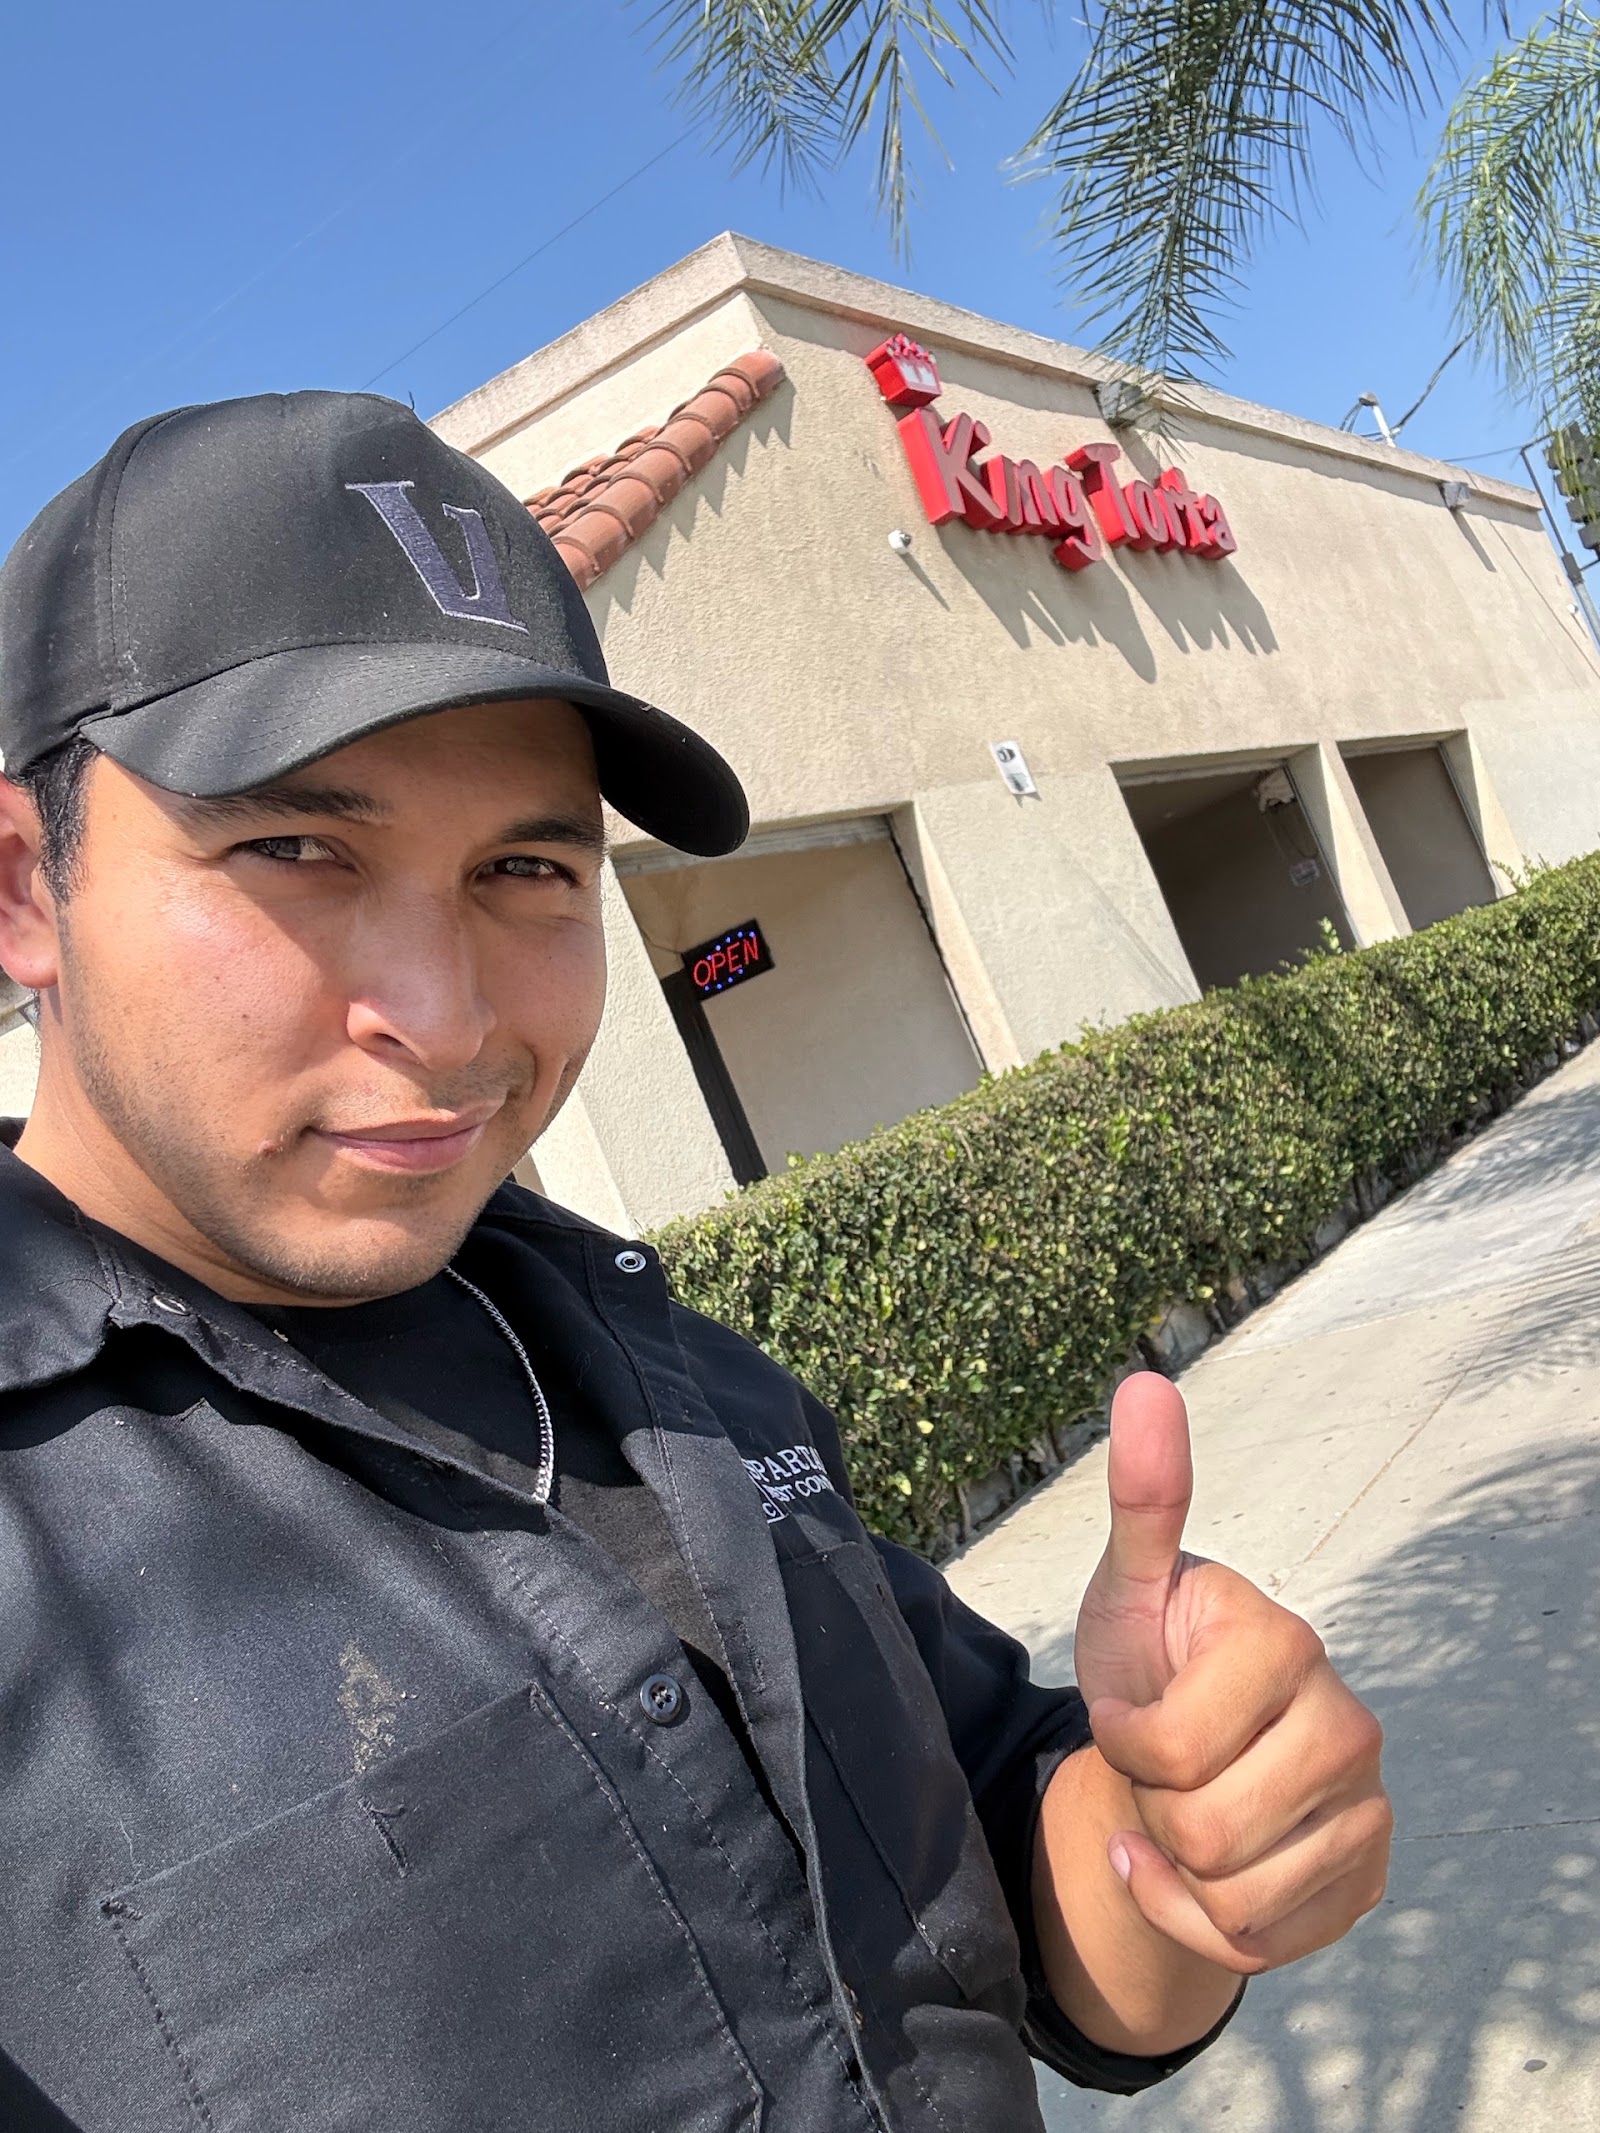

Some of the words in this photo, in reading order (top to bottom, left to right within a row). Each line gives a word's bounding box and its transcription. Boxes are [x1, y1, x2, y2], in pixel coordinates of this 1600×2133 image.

[898, 408, 1103, 571] King
[1065, 443, 1238, 560] Torta
[693, 935, 759, 987] OPEN
